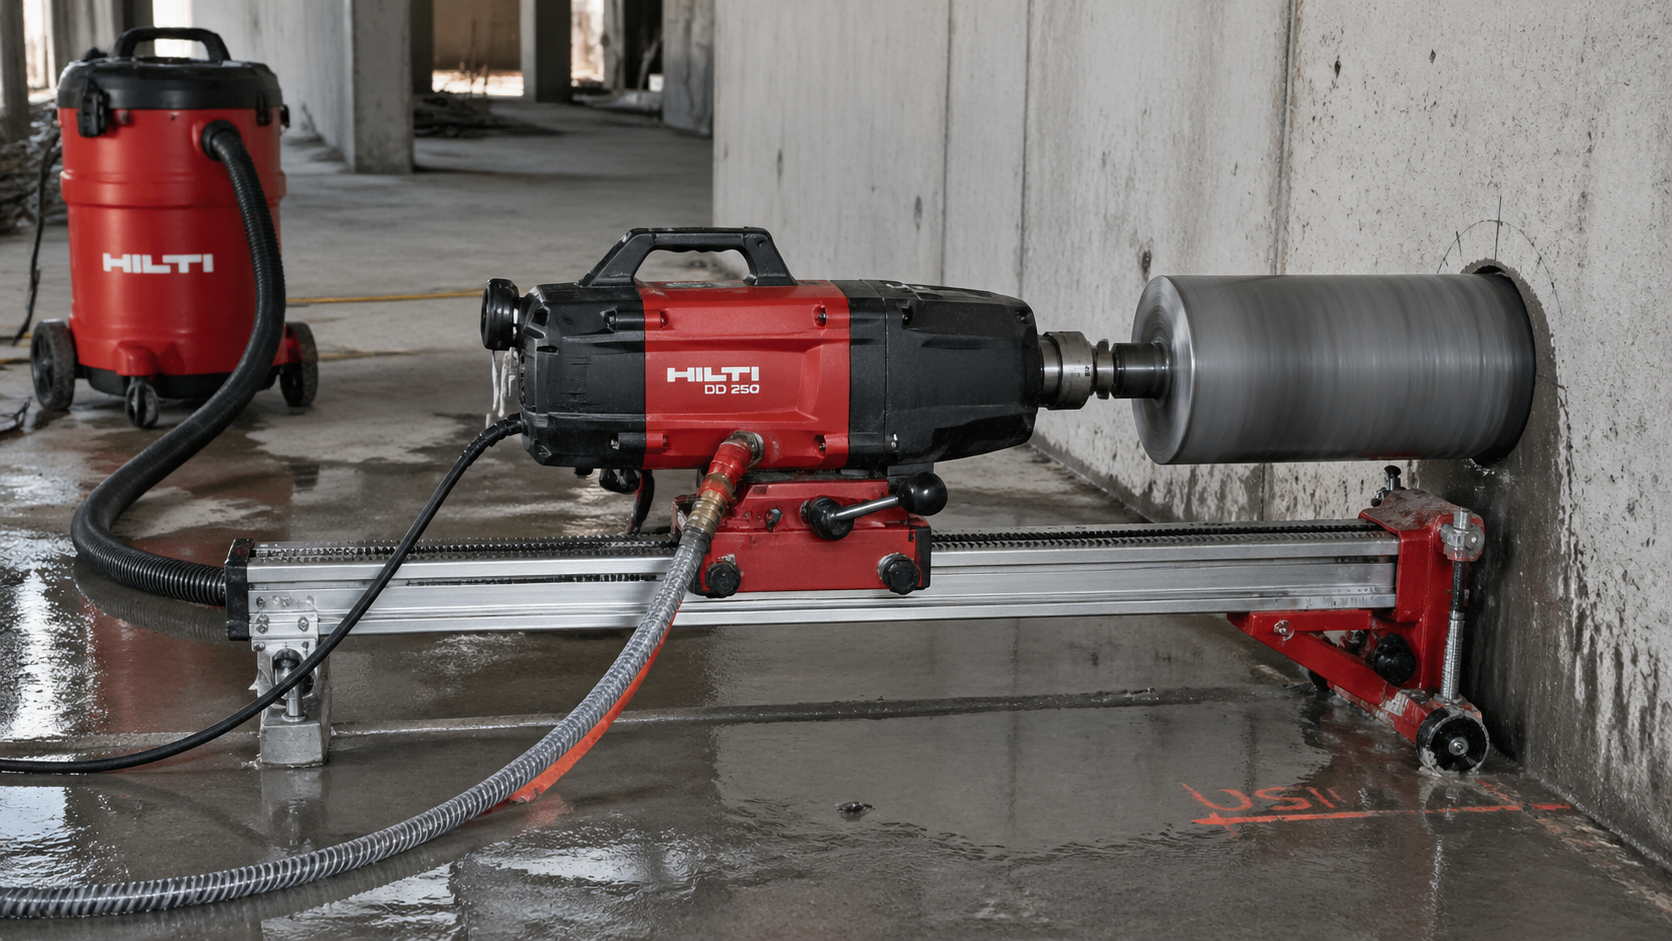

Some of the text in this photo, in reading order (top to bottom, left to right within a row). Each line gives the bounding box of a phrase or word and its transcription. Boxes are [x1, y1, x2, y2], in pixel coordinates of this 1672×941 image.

[102, 252, 214, 274] HILTI
[666, 366, 760, 383] HILTI
[704, 384, 760, 395] DD 250
